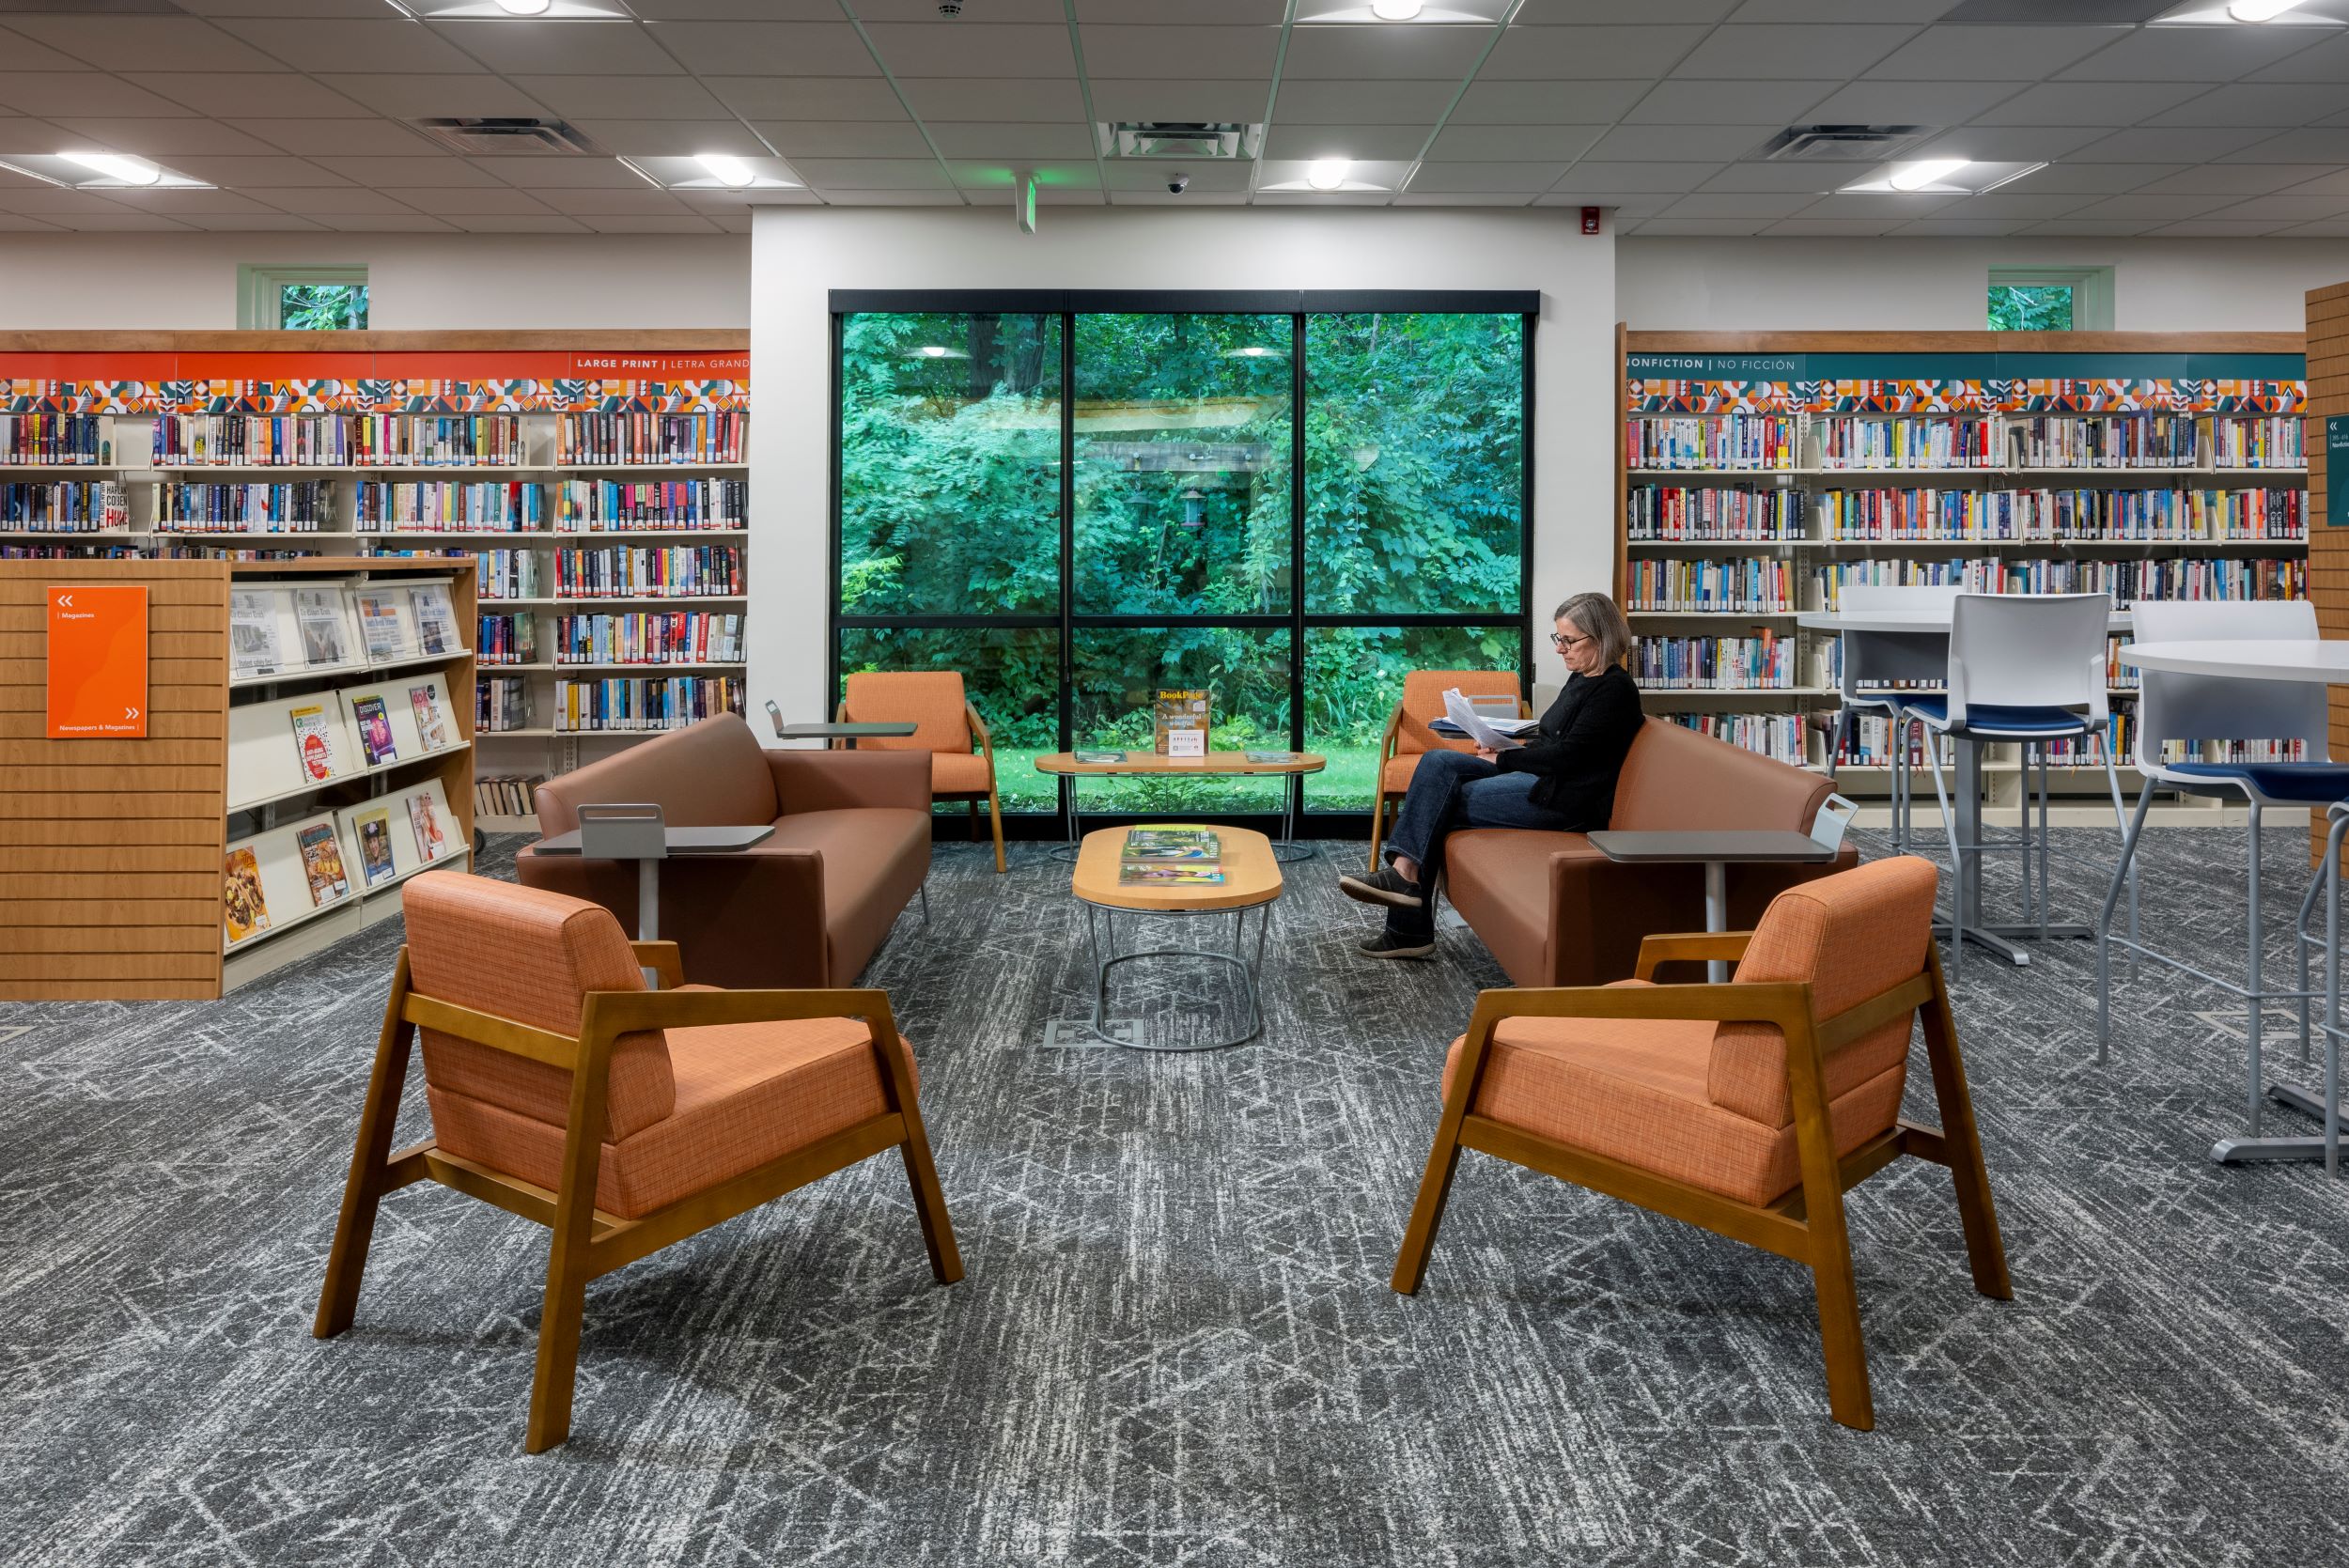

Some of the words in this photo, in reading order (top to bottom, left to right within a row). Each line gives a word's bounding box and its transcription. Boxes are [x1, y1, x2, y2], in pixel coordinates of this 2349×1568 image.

[577, 359, 616, 368] LARGE
[622, 359, 658, 368] PRINT
[671, 359, 705, 369] LETRA
[1718, 360, 1736, 369] NO
[1741, 359, 1795, 370] FICCIÓN
[1159, 691, 1204, 700] BookPage
[359, 702, 381, 714] DISCOVER
